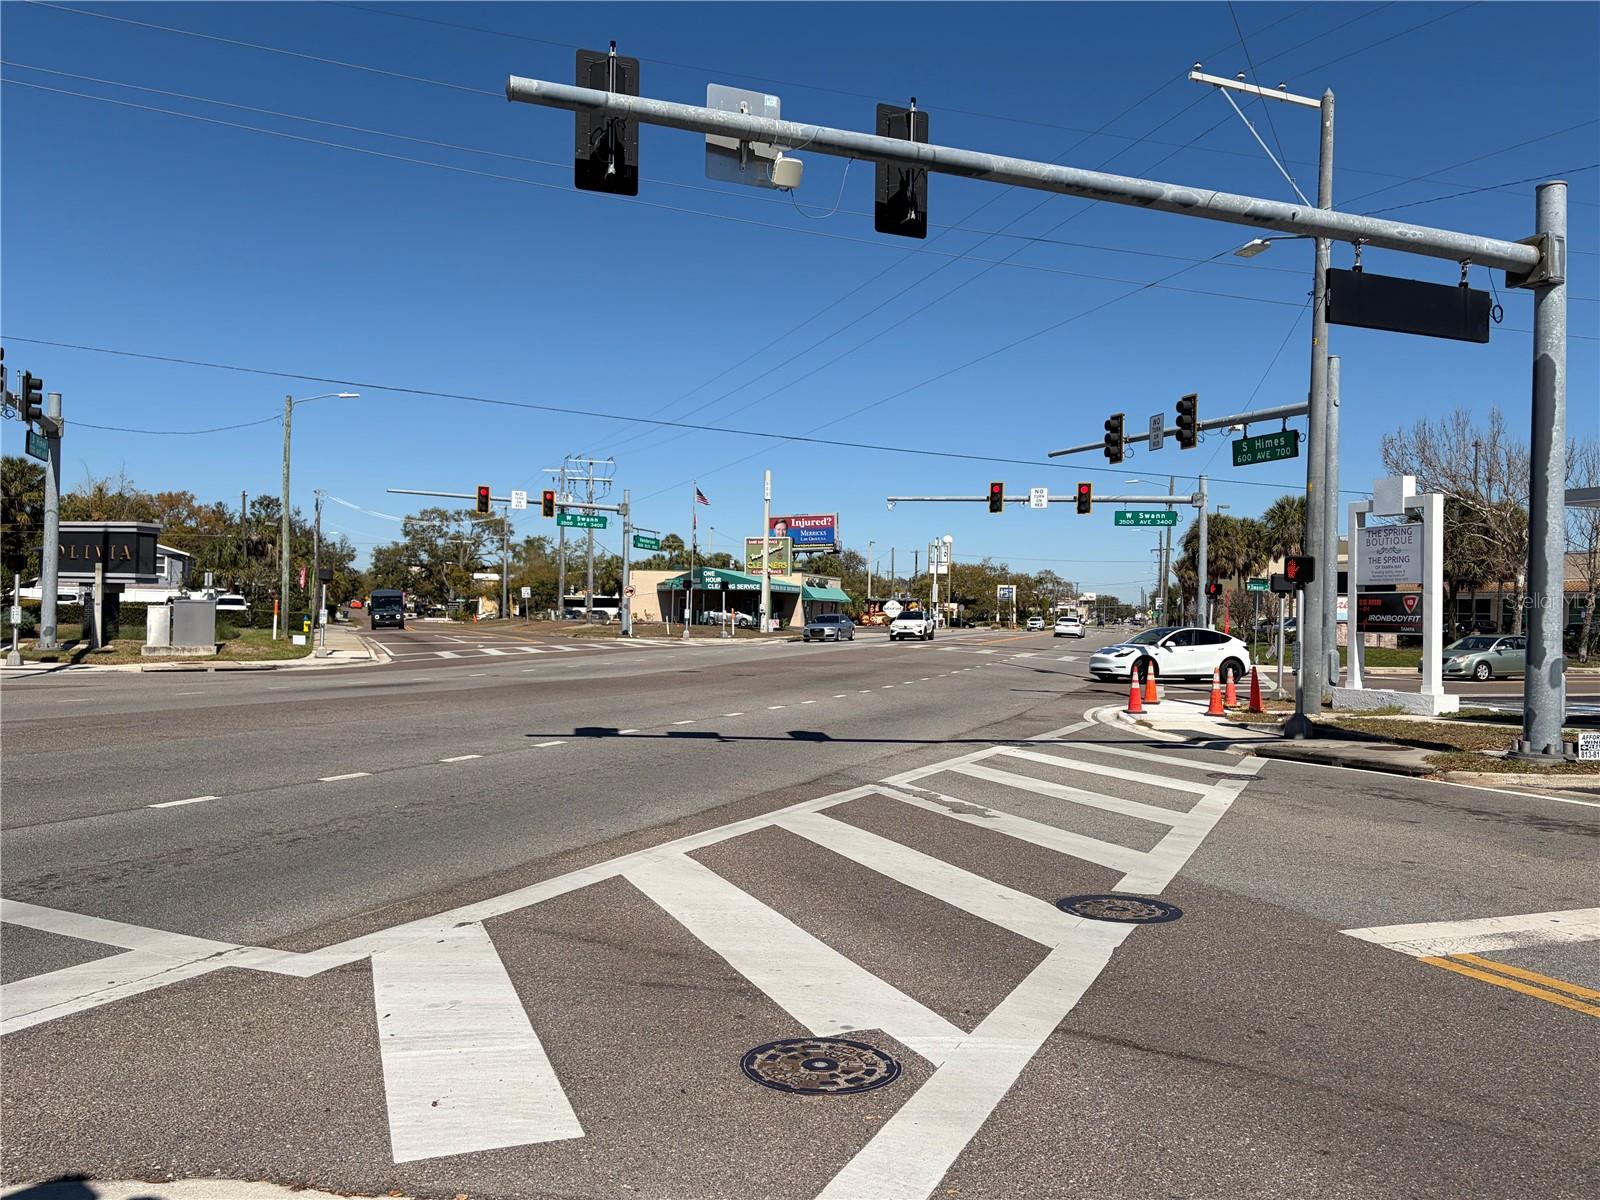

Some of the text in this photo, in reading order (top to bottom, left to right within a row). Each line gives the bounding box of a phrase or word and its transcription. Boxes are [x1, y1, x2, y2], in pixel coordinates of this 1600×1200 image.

[1242, 437, 1285, 452] S Himes
[1237, 447, 1291, 463] 600 AVE 700
[791, 517, 832, 528] Injured?
[1367, 527, 1413, 538] THE SPRING
[1366, 536, 1413, 547] BOUTIQUE
[1383, 555, 1410, 564] SPRING
[1367, 614, 1421, 623] IRONBODYFIT
